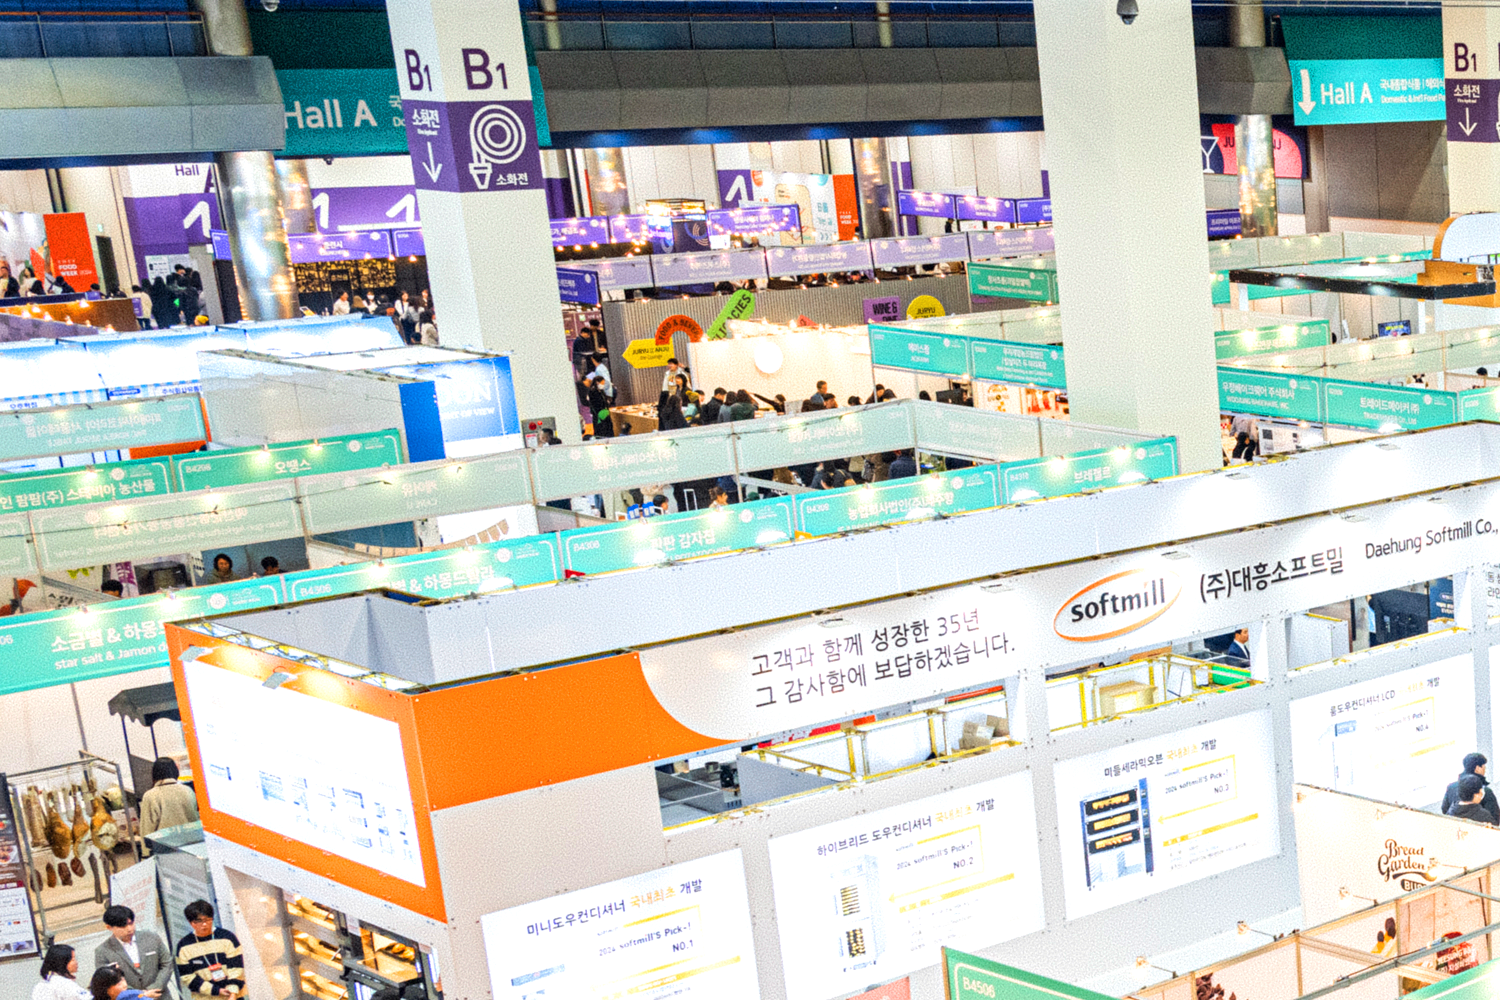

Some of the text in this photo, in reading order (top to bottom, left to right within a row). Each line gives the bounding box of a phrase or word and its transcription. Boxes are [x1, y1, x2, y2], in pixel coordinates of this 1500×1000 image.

[404, 49, 432, 92] B1
[462, 48, 508, 90] B1
[1454, 43, 1477, 72] B1
[1321, 83, 1373, 105] Hall A
[1453, 84, 1480, 98] 소화전
[285, 99, 343, 129] Hall
[354, 100, 377, 128] A
[412, 108, 440, 129] 소화전
[175, 164, 200, 176] Hall
[496, 172, 529, 186] 소화전
[118, 478, 156, 495] 농산물
[1365, 534, 1422, 560] Daehung
[1426, 521, 1473, 547] Softmill
[1475, 519, 1499, 536] Co.,
[1200, 546, 1344, 604] (주)대흥소프트밀
[1071, 578, 1165, 623] softmill
[107, 628, 121, 644] &
[751, 608, 981, 677] 고객과 함께 성장한 35년
[55, 646, 157, 671] star salt & Jamon
[755, 631, 1017, 709] 그 감사함에 보답하겠습니다.
[1381, 676, 1440, 702] LCD 개발
[1104, 753, 1164, 778] 미들세라믹오븐
[1201, 738, 1218, 751] 개발
[817, 833, 869, 857] 하이브리드
[872, 815, 932, 843] 도우컨디셔너
[976, 798, 995, 813] 개발
[1385, 838, 1424, 859] Bread
[953, 857, 974, 870] NO.2
[1378, 853, 1426, 882] Garden
[527, 878, 703, 936] 미니도우컨디셔너 국내최초 개발
[672, 939, 694, 953] NO.1
[963, 977, 995, 999] B4506
